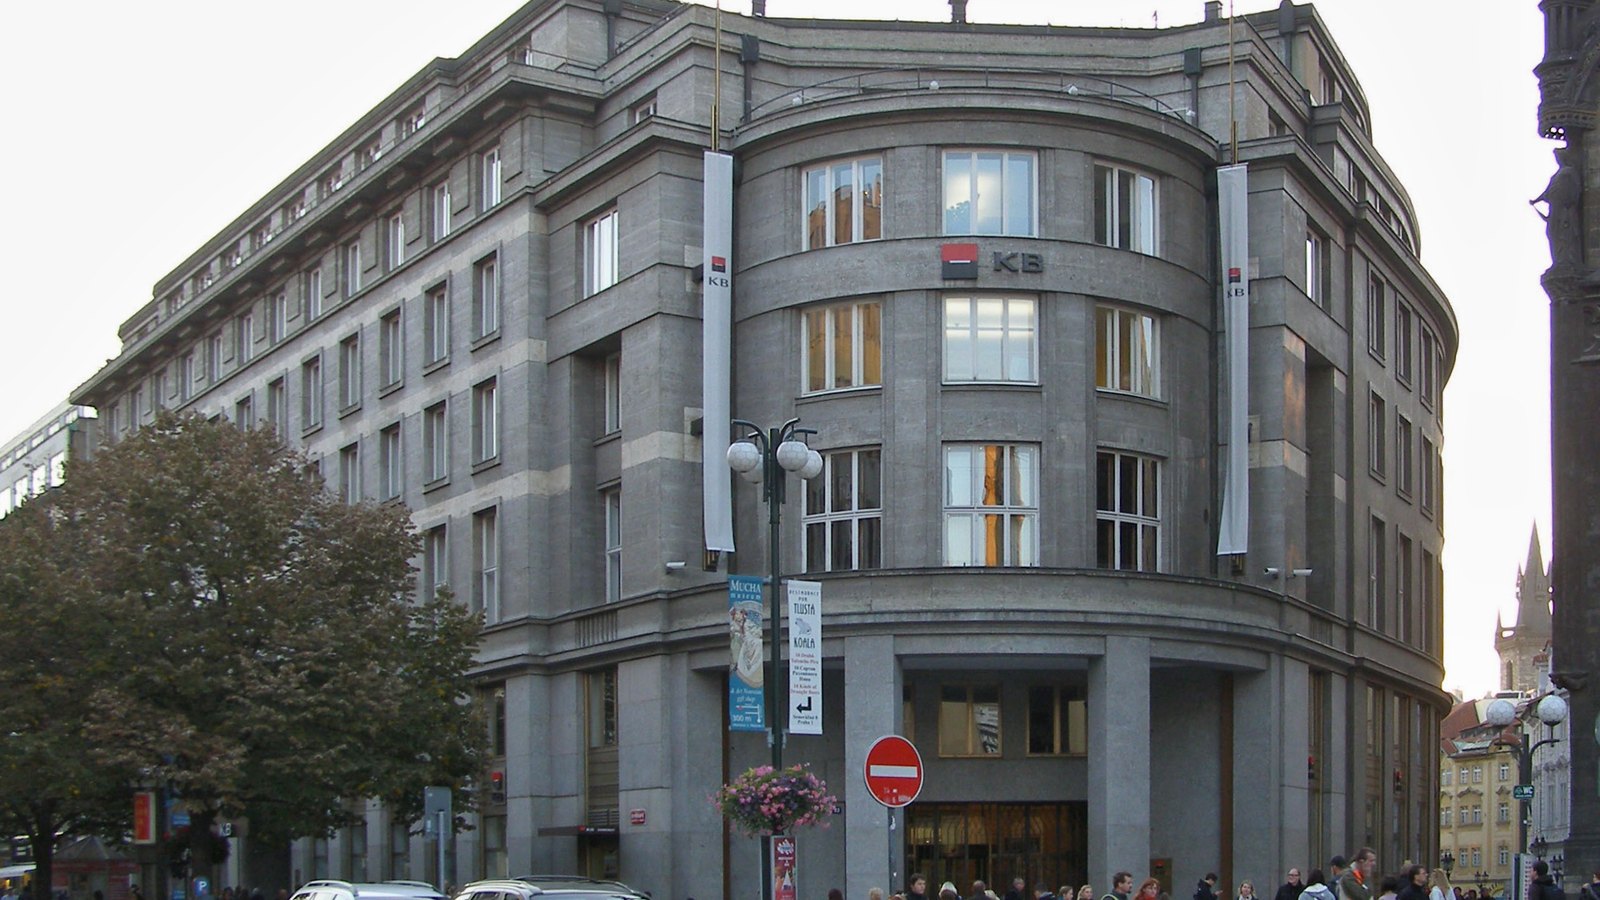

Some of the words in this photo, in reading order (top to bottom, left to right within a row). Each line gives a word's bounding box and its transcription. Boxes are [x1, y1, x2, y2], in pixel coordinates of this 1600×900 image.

[993, 251, 1043, 273] KB
[709, 277, 728, 287] KB
[1227, 288, 1245, 299] KB
[793, 637, 816, 649] KOALA
[1522, 786, 1534, 794] WC
